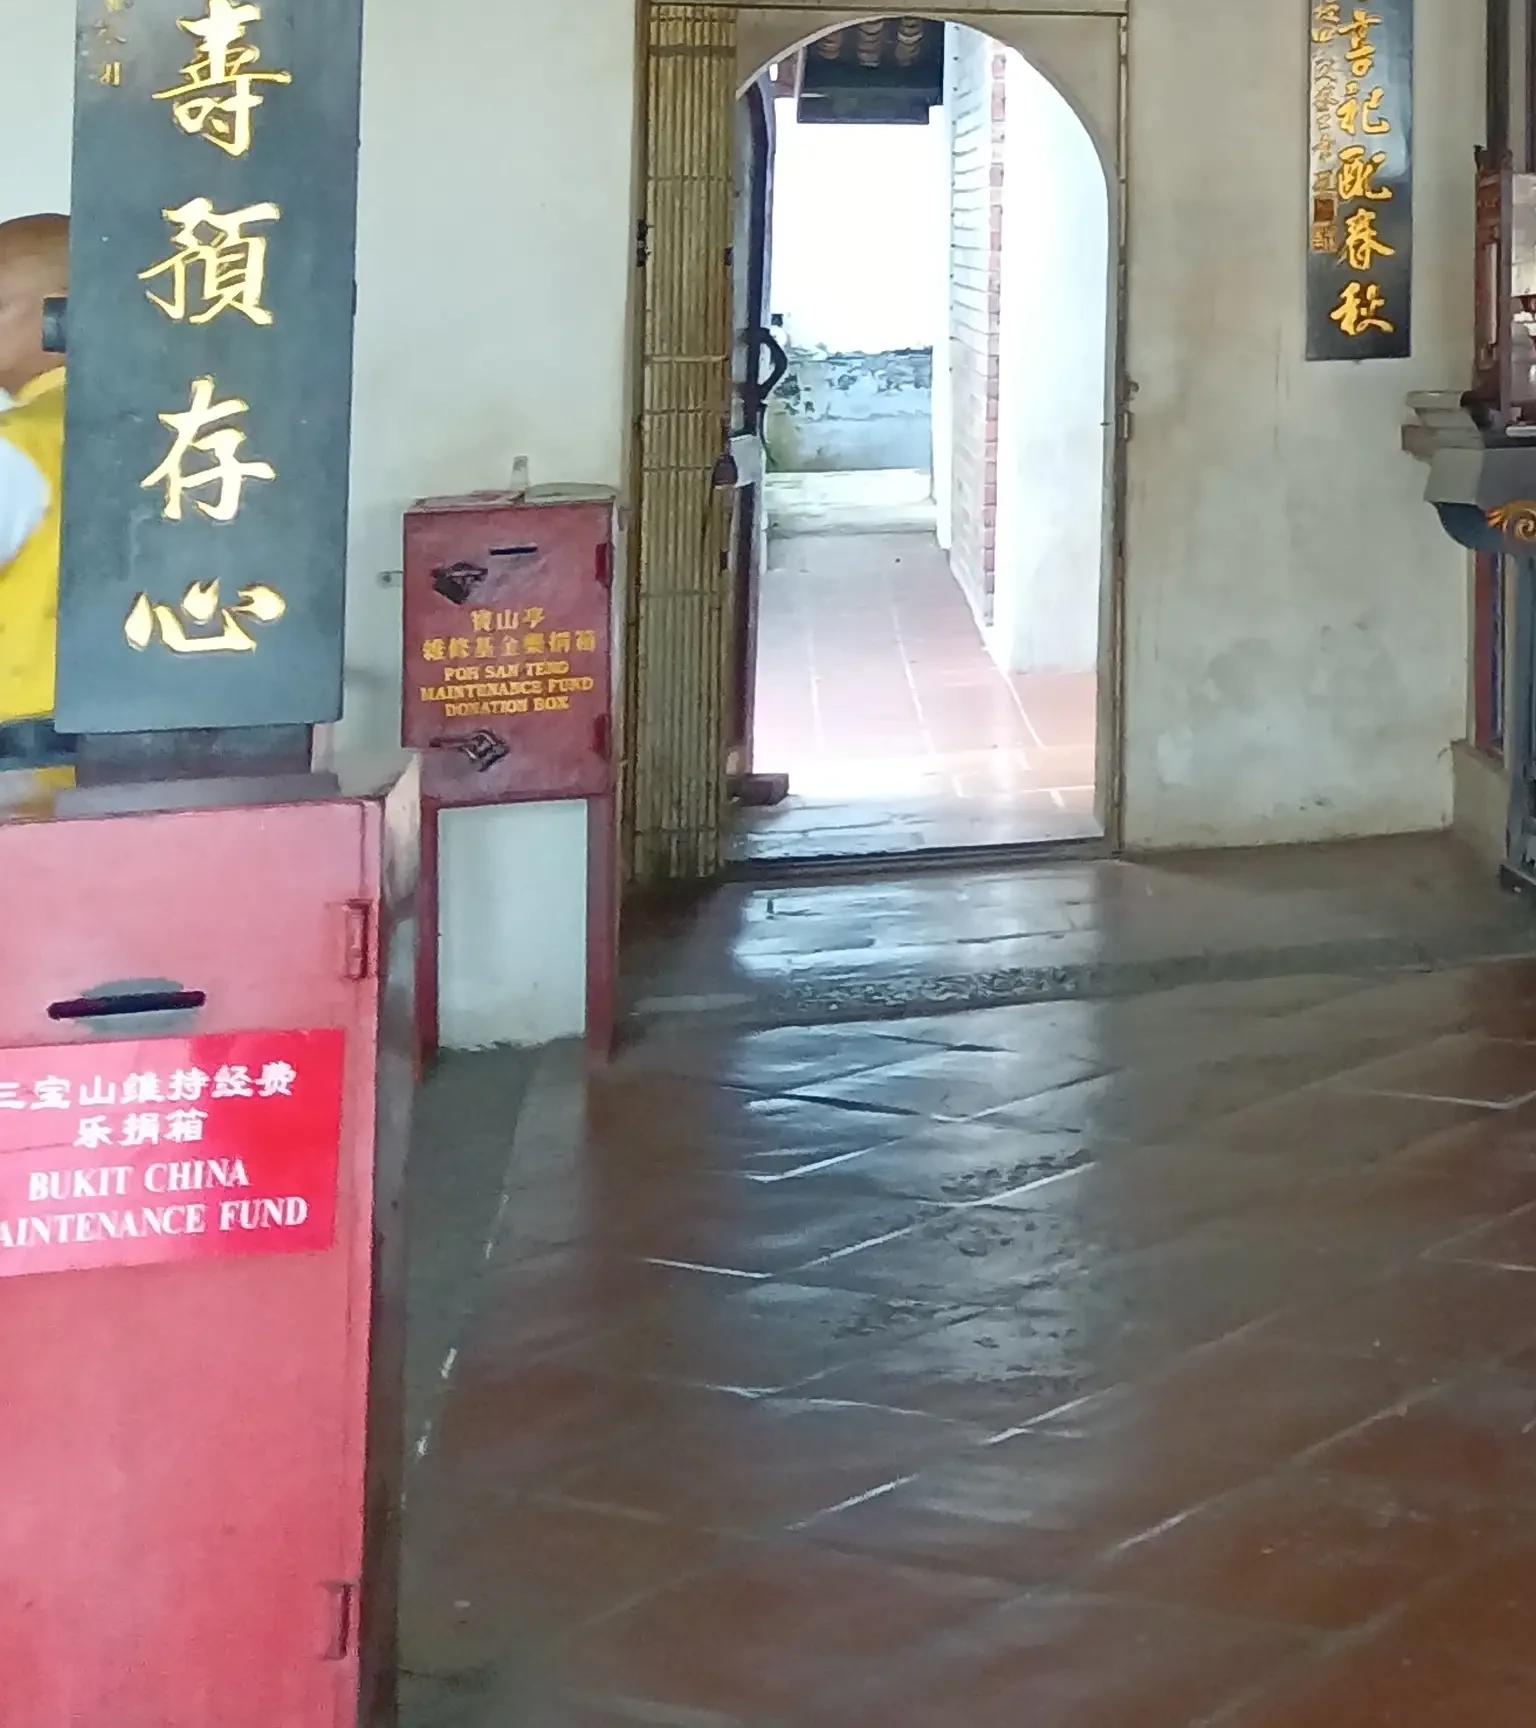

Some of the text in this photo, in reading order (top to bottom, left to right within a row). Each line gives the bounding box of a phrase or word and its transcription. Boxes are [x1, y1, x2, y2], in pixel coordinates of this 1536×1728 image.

[421, 676, 595, 702] MAINTENANCE FUND
[445, 695, 570, 717] DONATION BOX
[28, 1158, 251, 1202] BUKIT CHINA
[0, 1195, 309, 1250] AINTENANCE FUND
